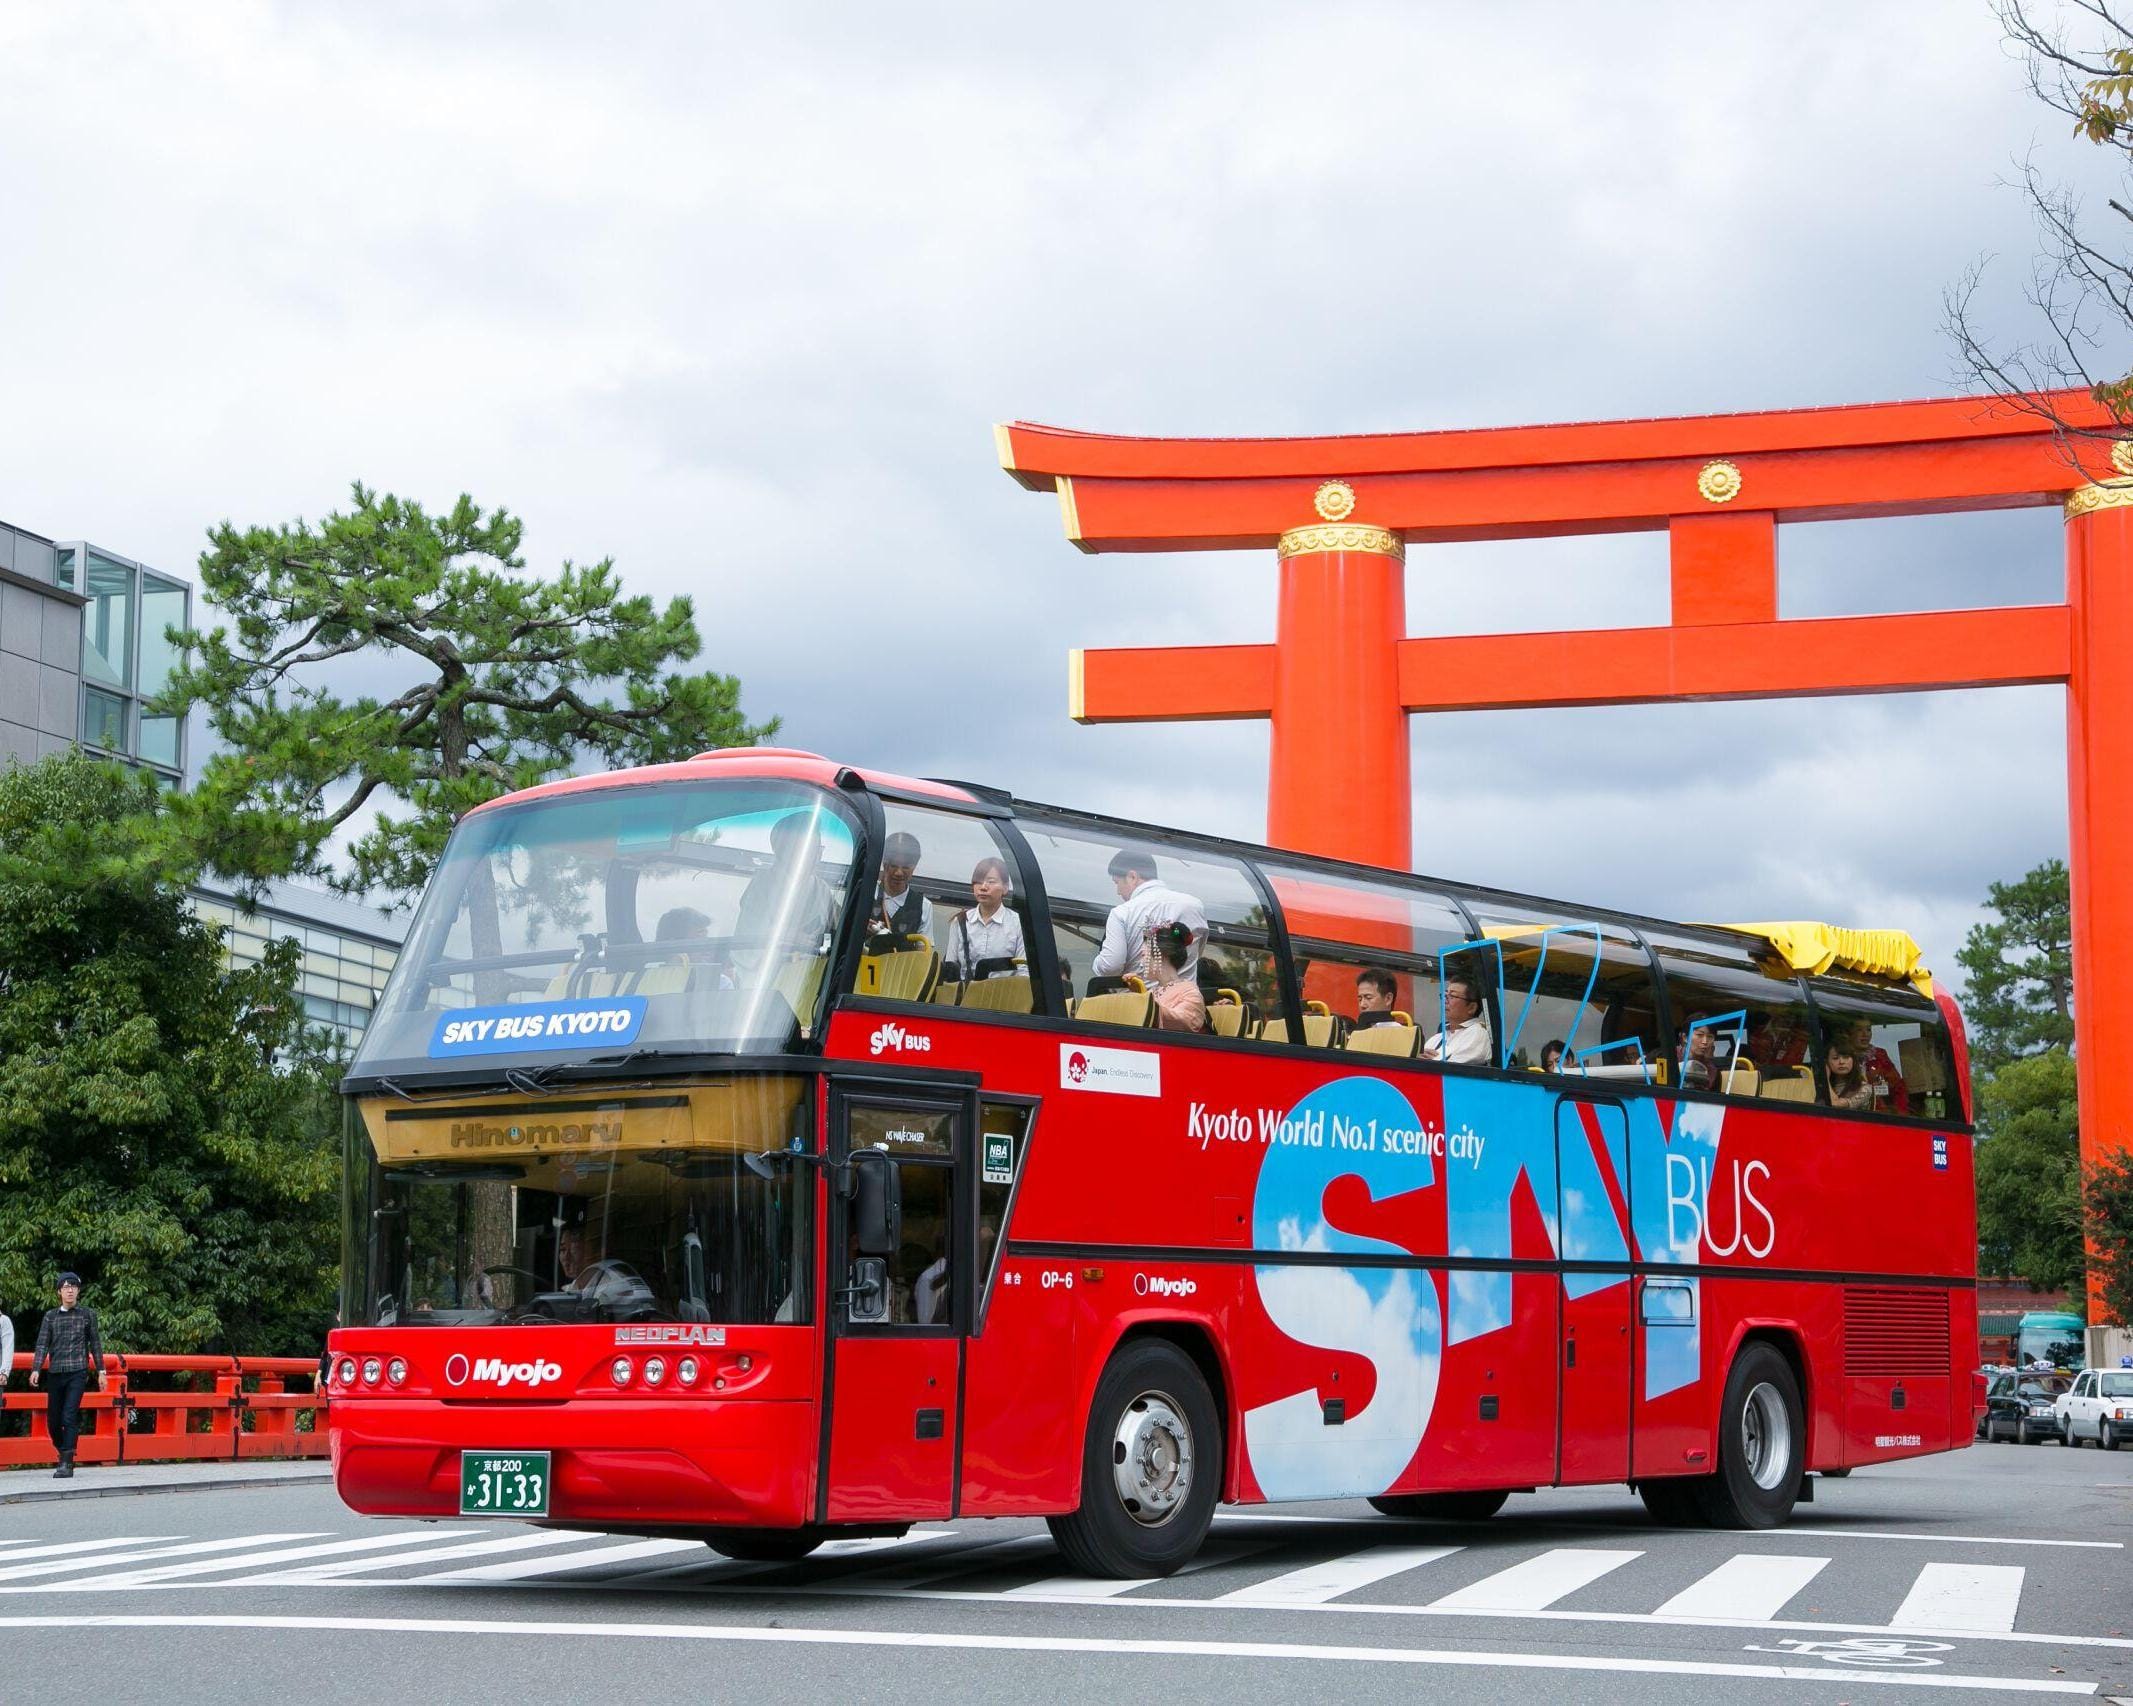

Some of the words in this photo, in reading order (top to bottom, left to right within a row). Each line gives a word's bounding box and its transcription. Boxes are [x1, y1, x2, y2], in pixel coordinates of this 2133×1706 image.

[867, 964, 875, 986] 1
[443, 1019, 495, 1044] SKY
[494, 1015, 545, 1039] BUS
[546, 1010, 631, 1036] KYOTO
[870, 1022, 906, 1055] SKY
[905, 1034, 931, 1052] BUS
[450, 1122, 622, 1148] Hinomaru
[1187, 1102, 1252, 1151] Kyoto
[1257, 1107, 1325, 1147] World
[1331, 1114, 1378, 1151] No.1
[1383, 1121, 1444, 1157] scenic
[1450, 1124, 1486, 1170] city
[1933, 1140, 1947, 1151] SKY
[990, 1144, 1008, 1157] NBA
[1934, 1153, 1947, 1165] BUS
[1665, 1153, 1776, 1259] BUS
[1041, 1271, 1073, 1289] OP-6
[1149, 1276, 1197, 1297] Myojo
[614, 1326, 726, 1346] NEOPLAN
[472, 1358, 562, 1387] Myojo
